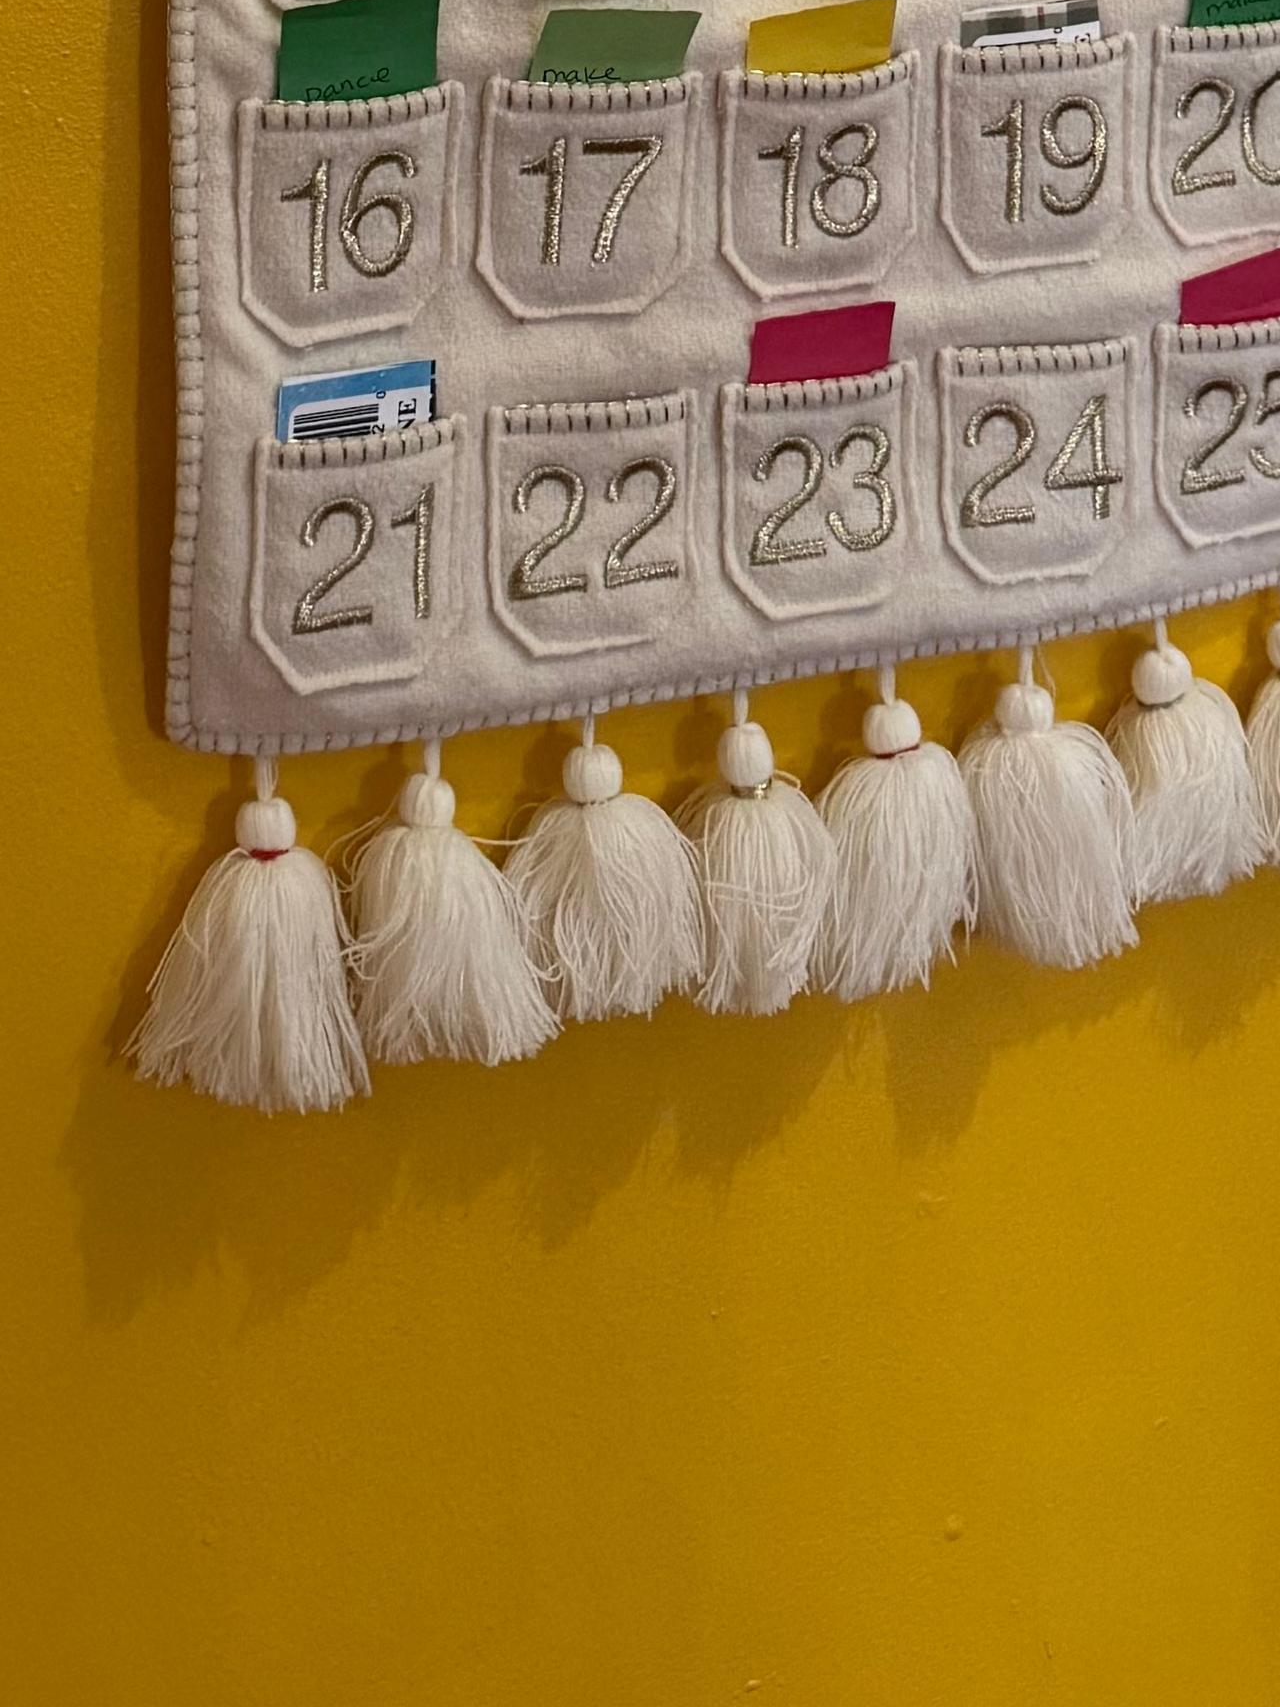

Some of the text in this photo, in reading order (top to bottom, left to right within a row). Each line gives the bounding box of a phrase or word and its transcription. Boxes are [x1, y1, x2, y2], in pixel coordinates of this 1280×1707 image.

[542, 67, 621, 83] make
[280, 150, 417, 293] 16
[519, 135, 663, 268] 17
[757, 120, 882, 249] 18
[980, 93, 1108, 223] 19
[292, 482, 436, 635] 21
[507, 455, 679, 600] 22
[750, 422, 898, 566] 23
[960, 393, 1123, 529] 24
